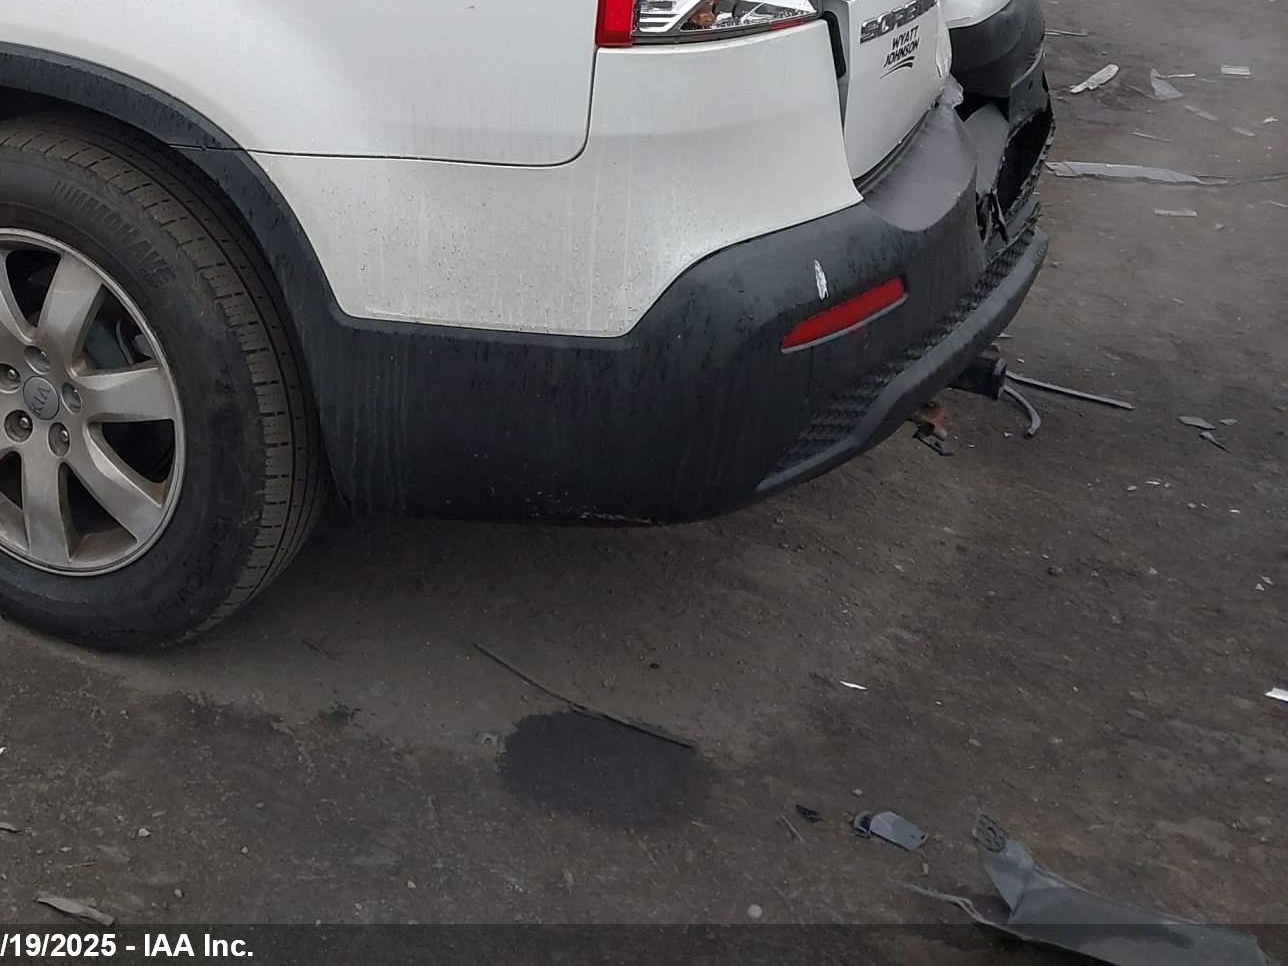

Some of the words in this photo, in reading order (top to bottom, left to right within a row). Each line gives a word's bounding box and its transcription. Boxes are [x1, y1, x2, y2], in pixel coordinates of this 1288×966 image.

[892, 25, 919, 50] WYATT
[883, 37, 920, 68] JOHNSON
[28, 387, 51, 416] KIA
